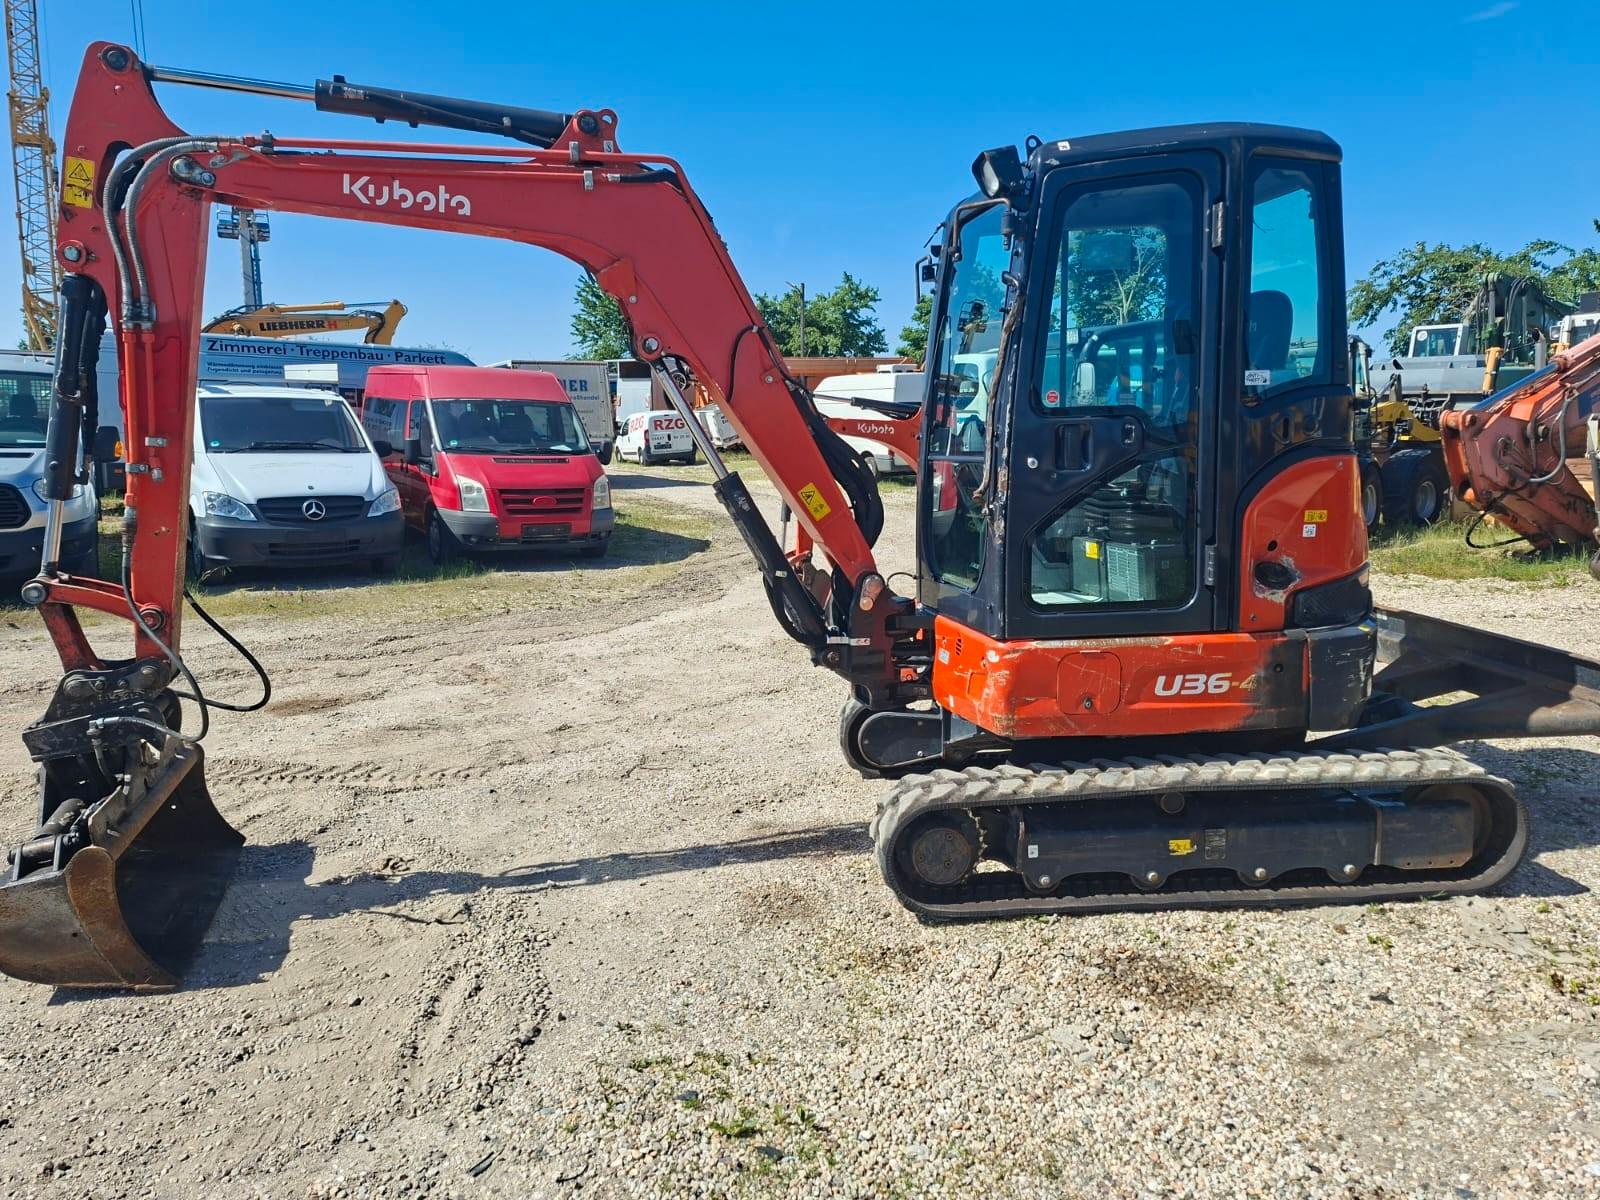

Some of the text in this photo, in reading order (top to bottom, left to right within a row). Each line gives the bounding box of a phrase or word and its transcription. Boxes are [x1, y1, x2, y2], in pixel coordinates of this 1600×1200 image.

[342, 173, 471, 216] Kubota
[259, 320, 326, 331] LIEBHERR
[207, 339, 447, 365] Zimmerei Treppenbau Parkett
[630, 415, 644, 433] RZG
[654, 418, 685, 431] RZG
[857, 423, 895, 434] Kubota
